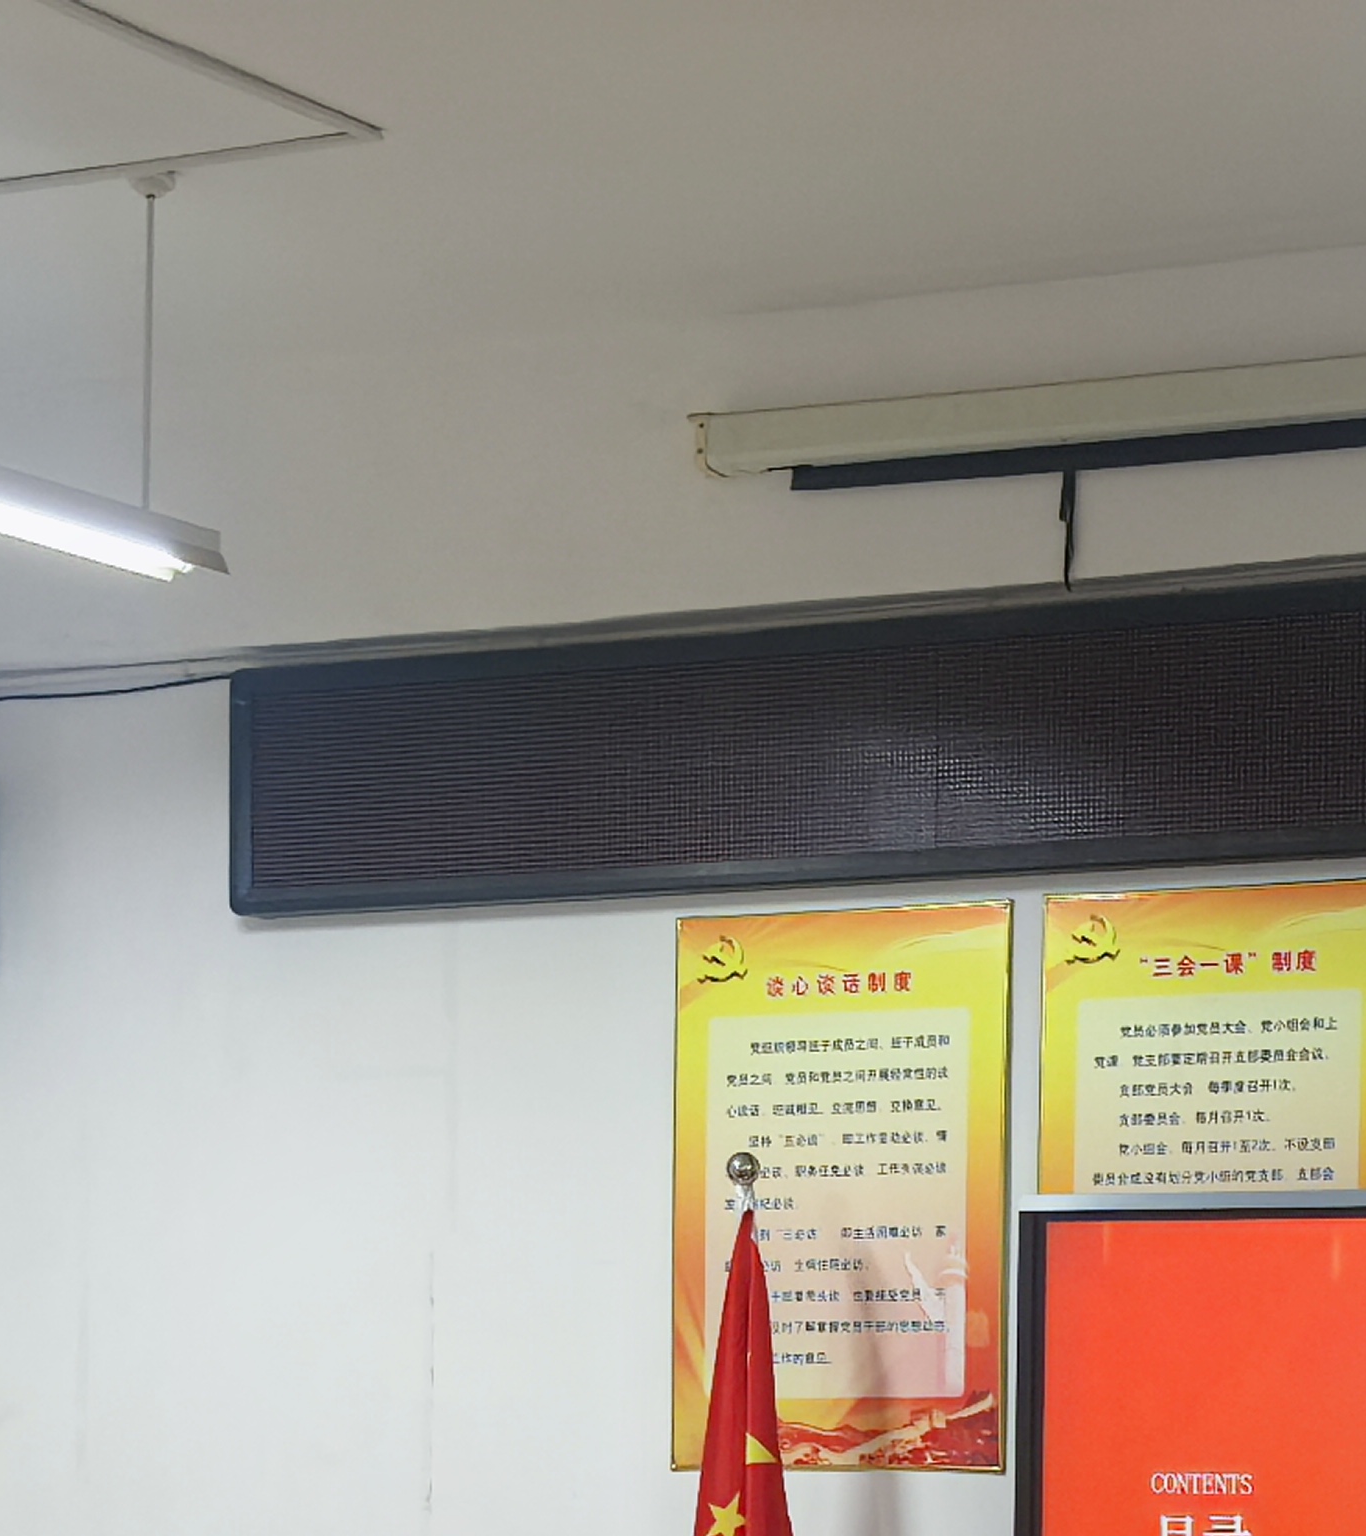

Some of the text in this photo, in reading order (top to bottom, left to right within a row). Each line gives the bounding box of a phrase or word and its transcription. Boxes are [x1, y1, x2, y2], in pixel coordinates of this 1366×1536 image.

[1140, 950, 1317, 977] “三会一课”制度
[767, 971, 912, 997] 谈心谈话制度
[1150, 1472, 1254, 1496] CONTENTS
